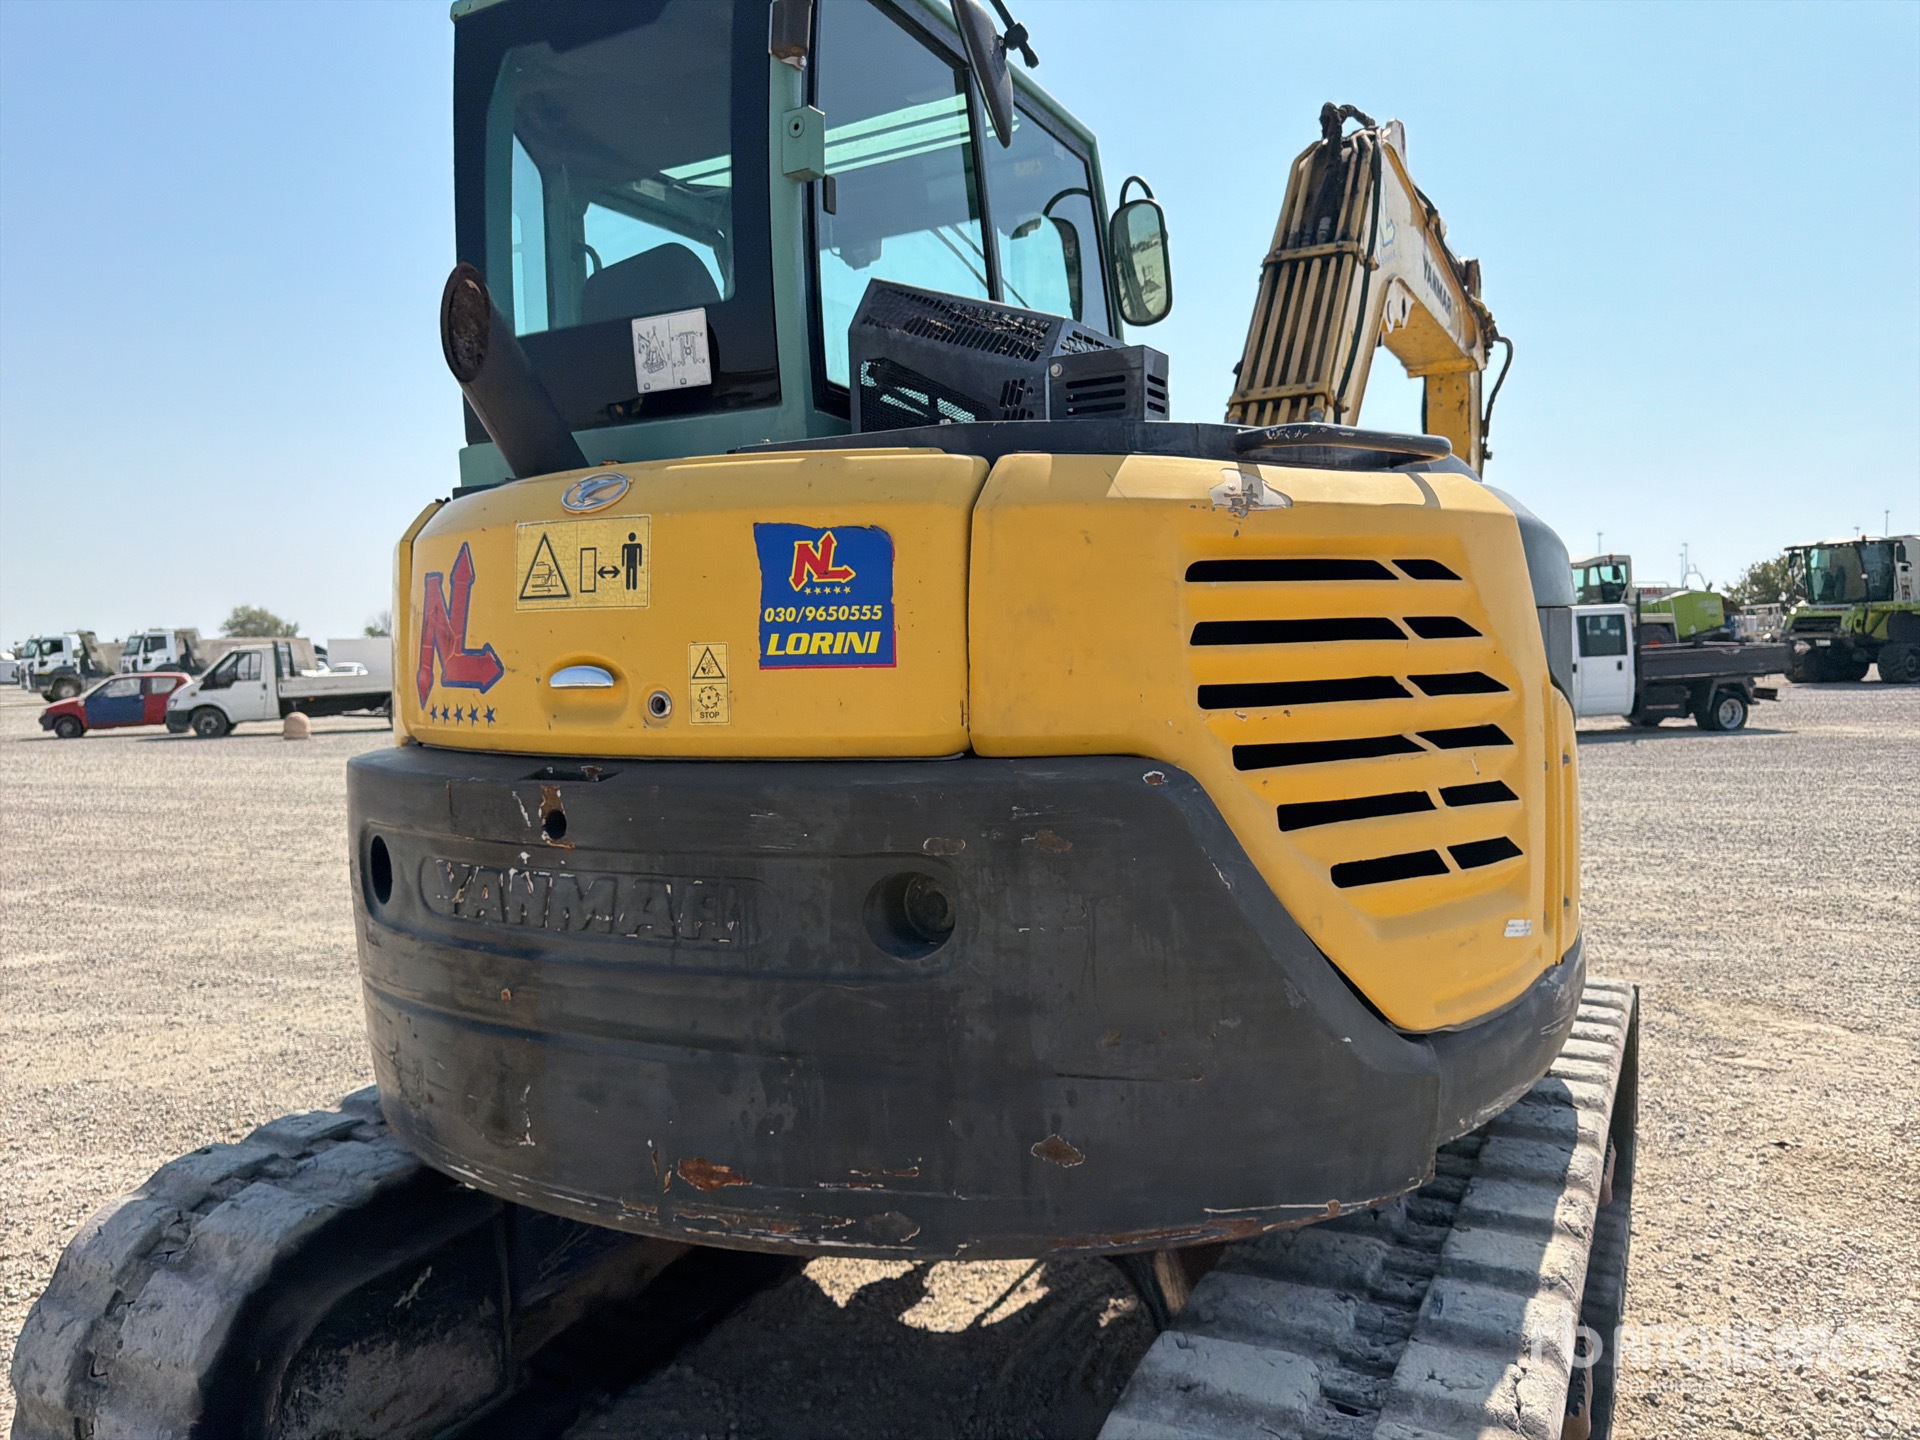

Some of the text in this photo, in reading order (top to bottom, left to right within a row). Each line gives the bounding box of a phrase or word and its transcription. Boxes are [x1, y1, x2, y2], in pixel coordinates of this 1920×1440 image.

[764, 605, 883, 623] 030/9650555
[767, 631, 881, 656] LORINI
[700, 711, 720, 719] STOP
